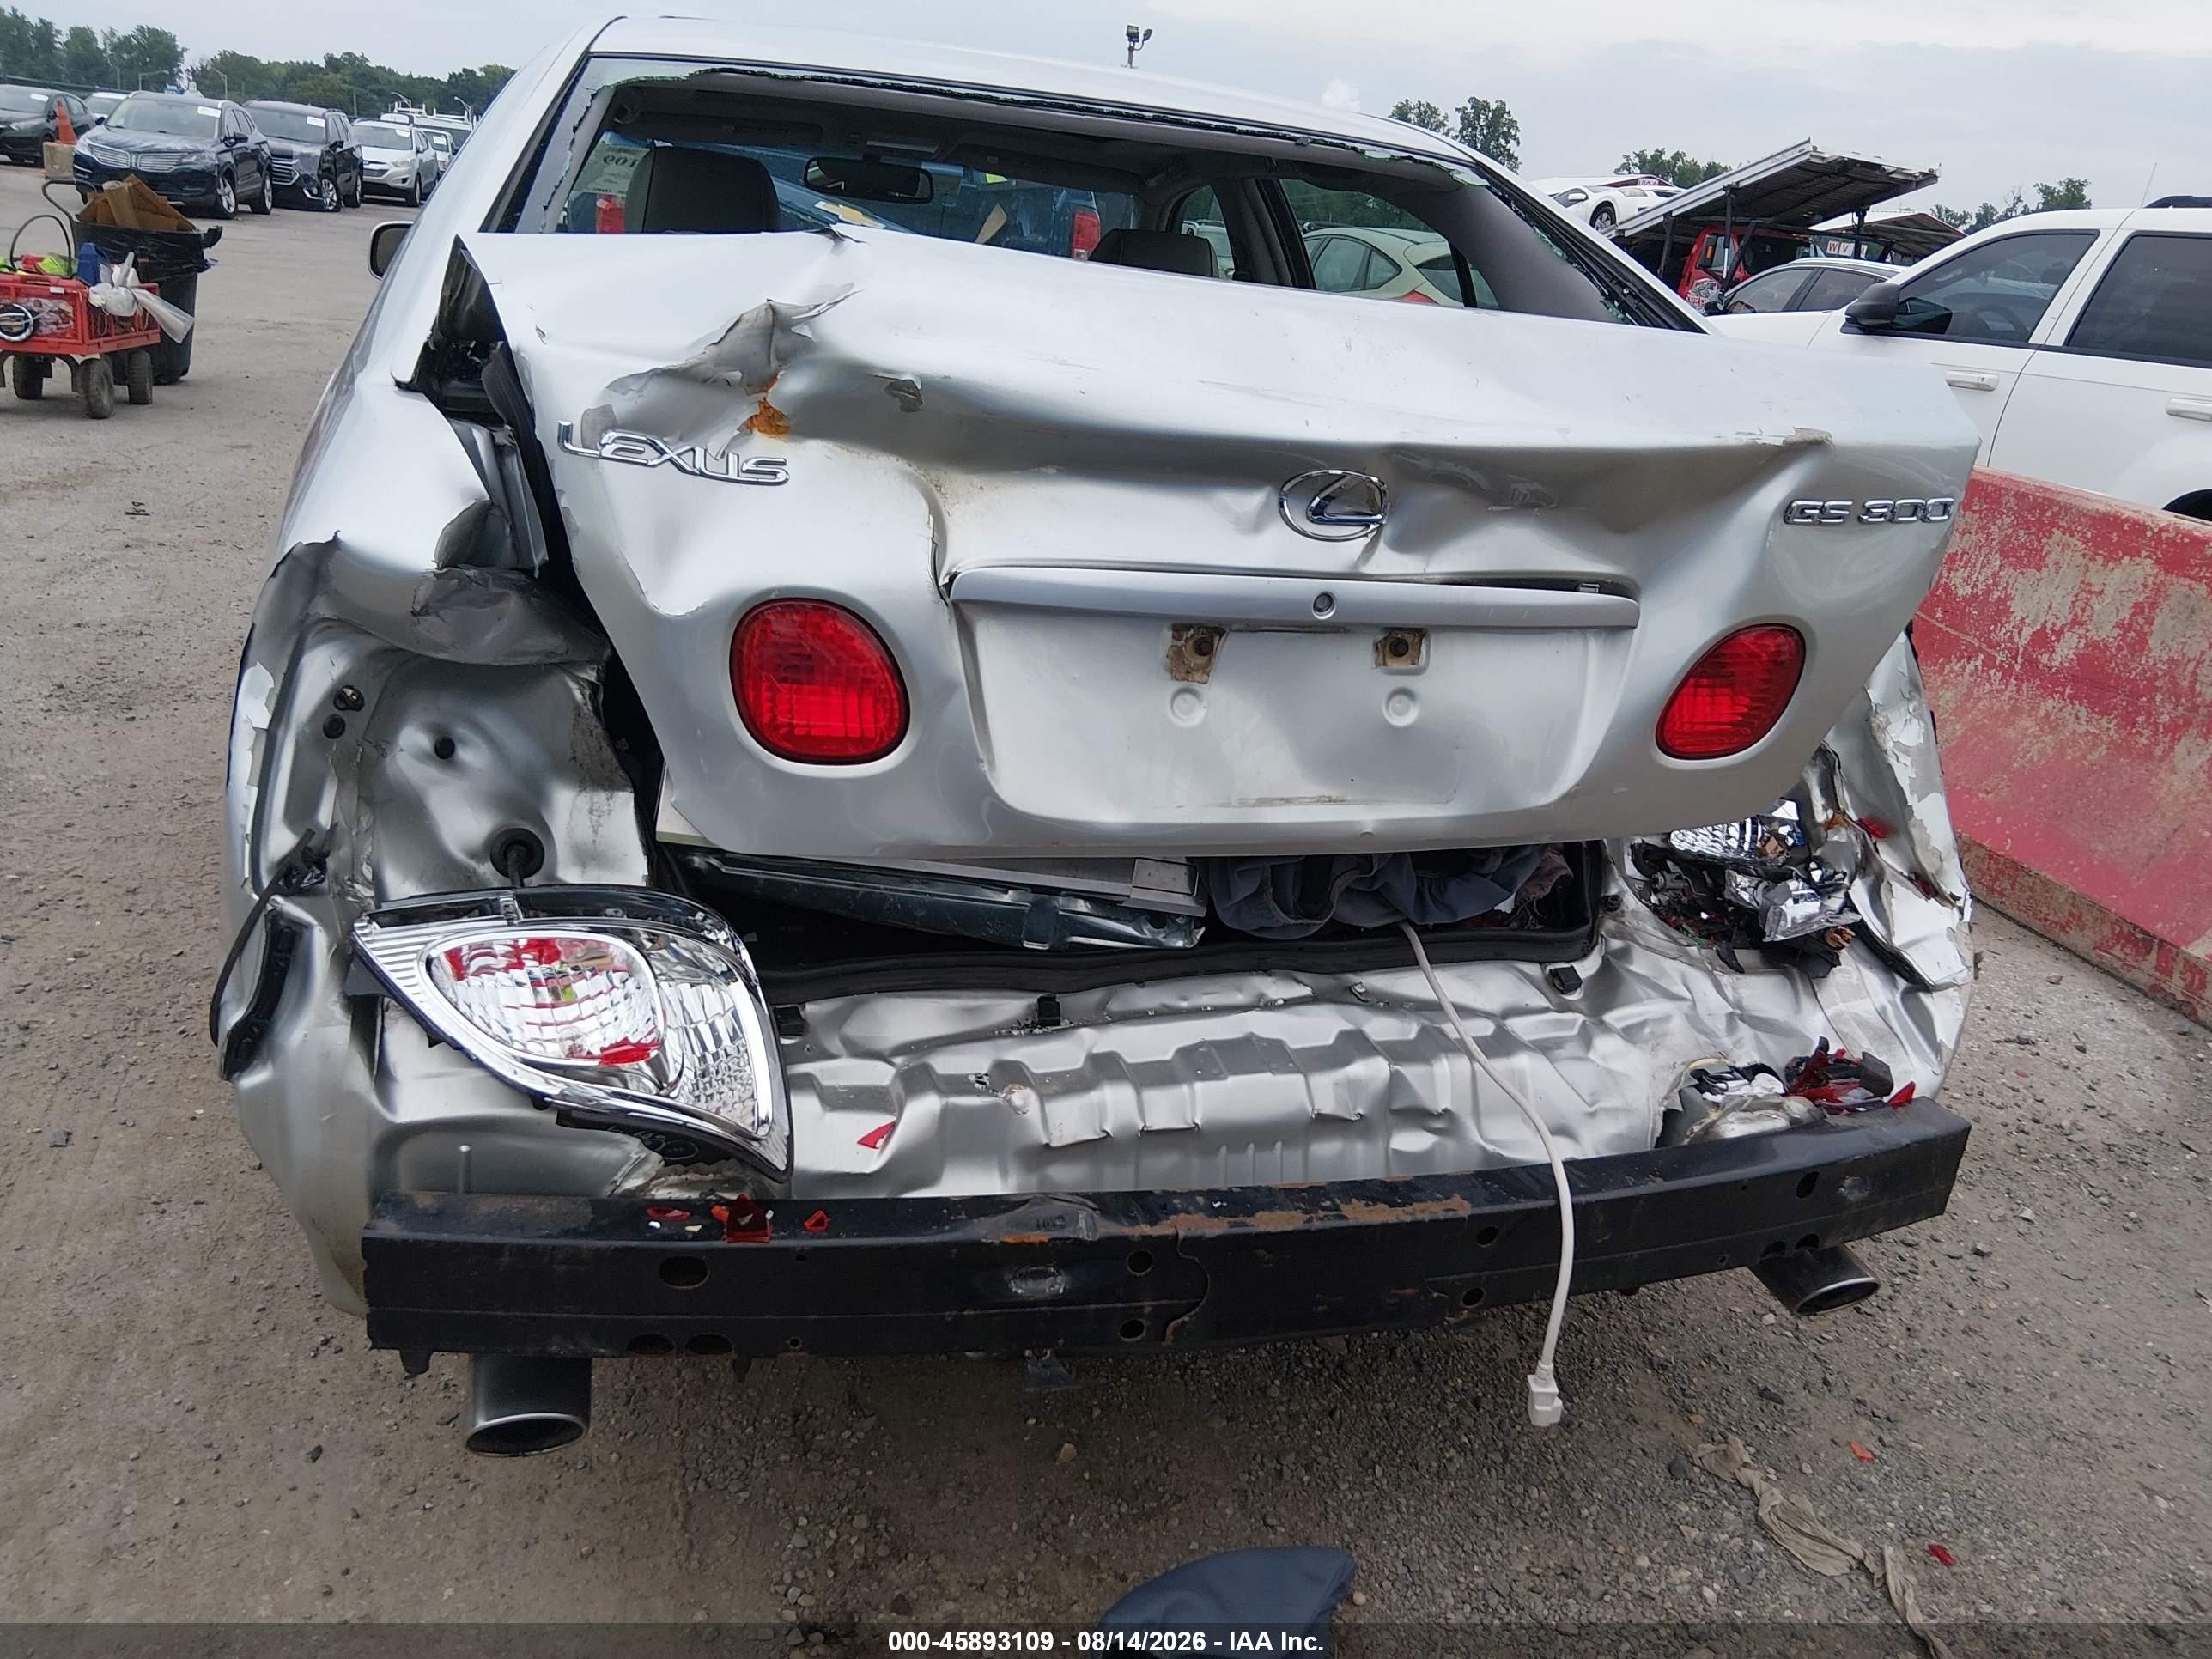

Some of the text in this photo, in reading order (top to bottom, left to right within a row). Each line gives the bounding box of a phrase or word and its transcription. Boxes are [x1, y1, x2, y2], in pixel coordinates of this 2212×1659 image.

[557, 420, 790, 486] LEXUS
[1784, 496, 1955, 525] GS 300
